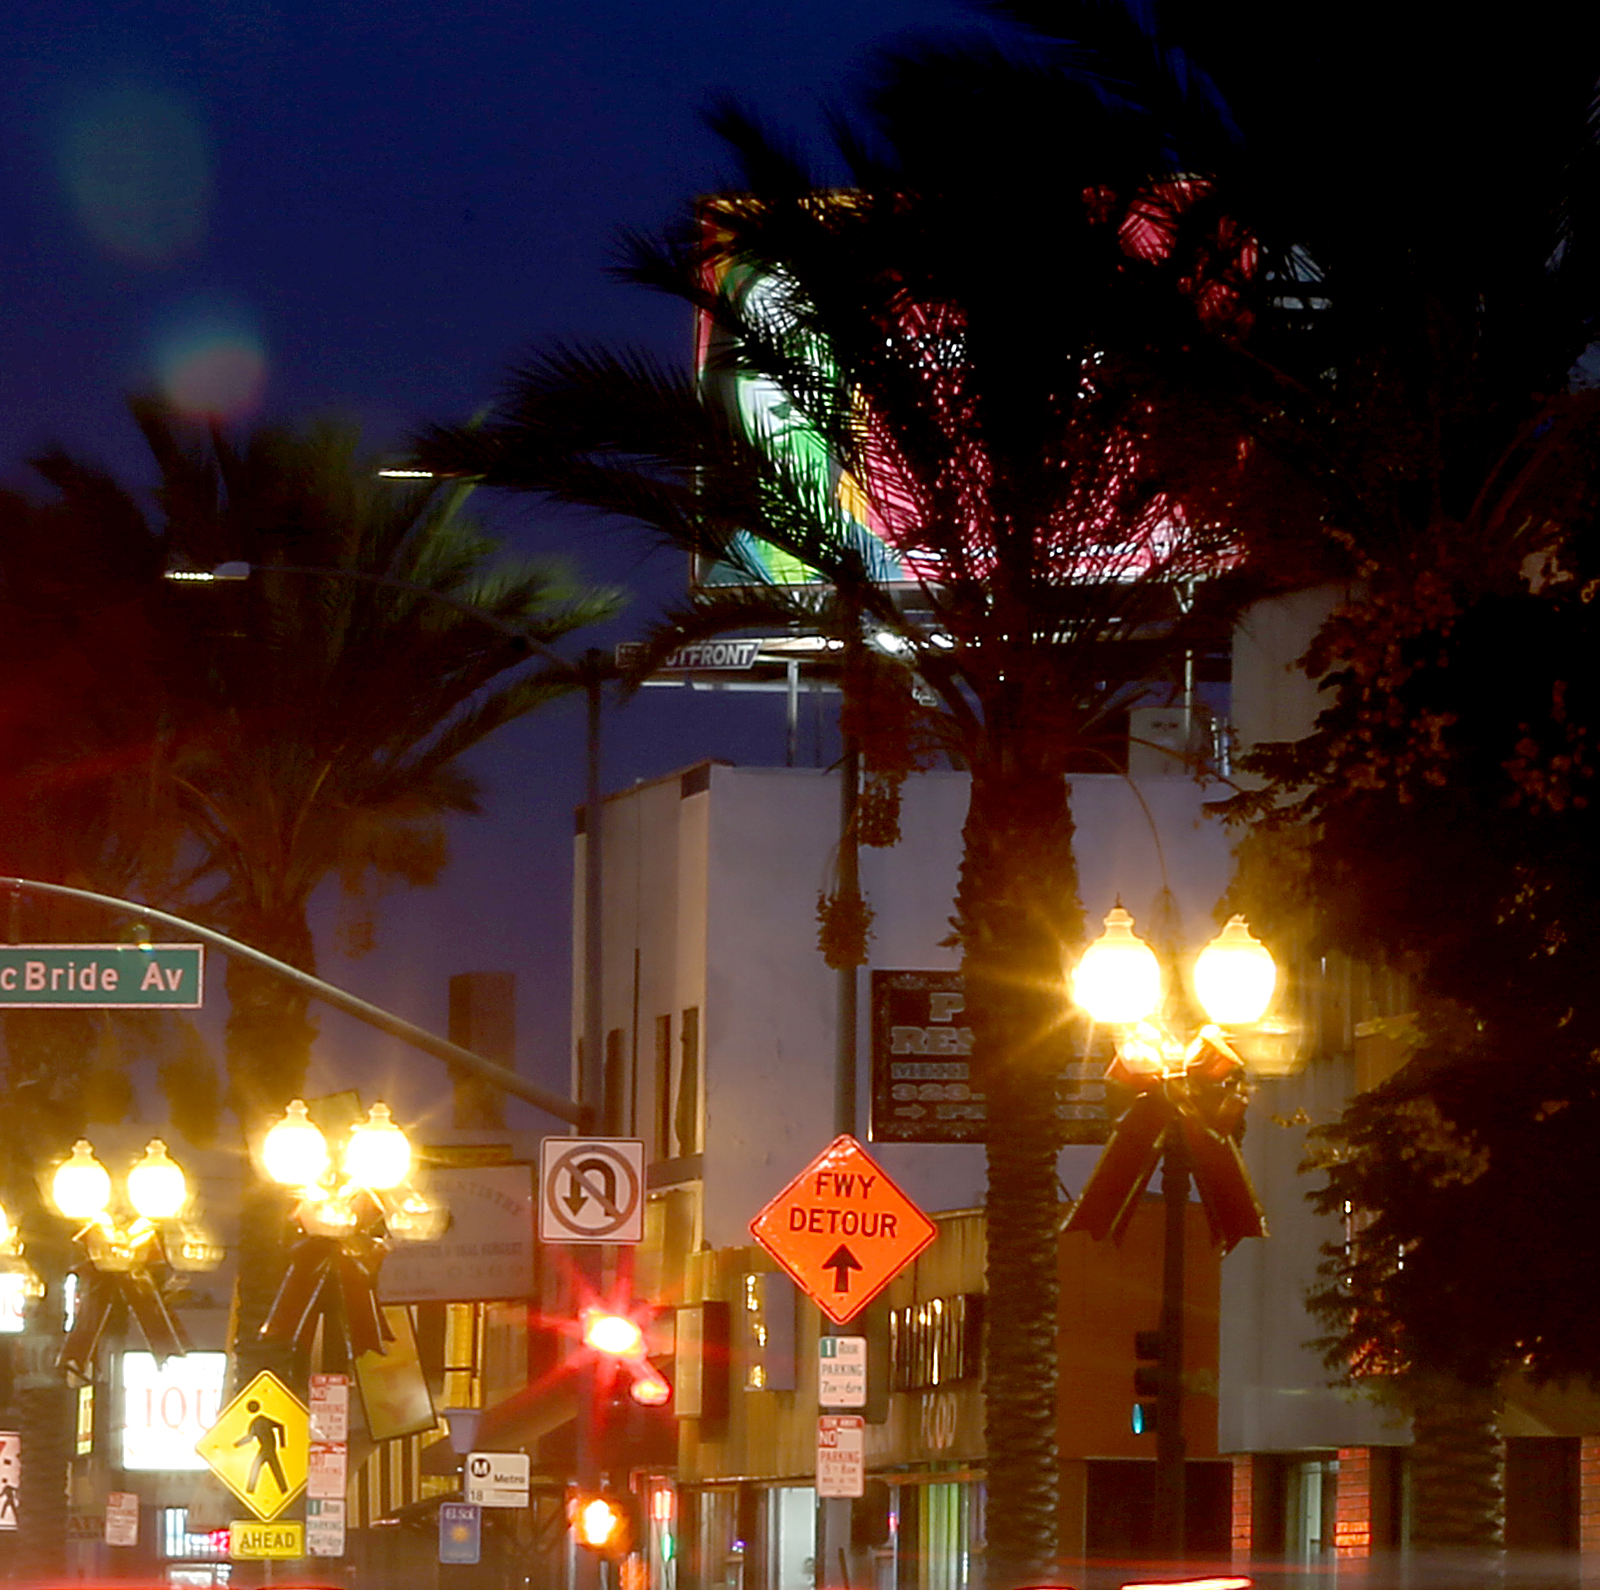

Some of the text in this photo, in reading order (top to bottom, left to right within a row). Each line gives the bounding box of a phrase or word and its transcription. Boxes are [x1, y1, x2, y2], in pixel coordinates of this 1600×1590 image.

[140, 962, 184, 991] Av
[815, 1172, 877, 1200] FWY
[789, 1207, 898, 1239] DETOUR
[821, 1364, 863, 1376] PARKING
[820, 1430, 836, 1447] NO
[820, 1451, 860, 1463] PARKING
[494, 1474, 526, 1483] Metro
[445, 1507, 475, 1519] El Sol
[240, 1531, 295, 1549] AHEAD
